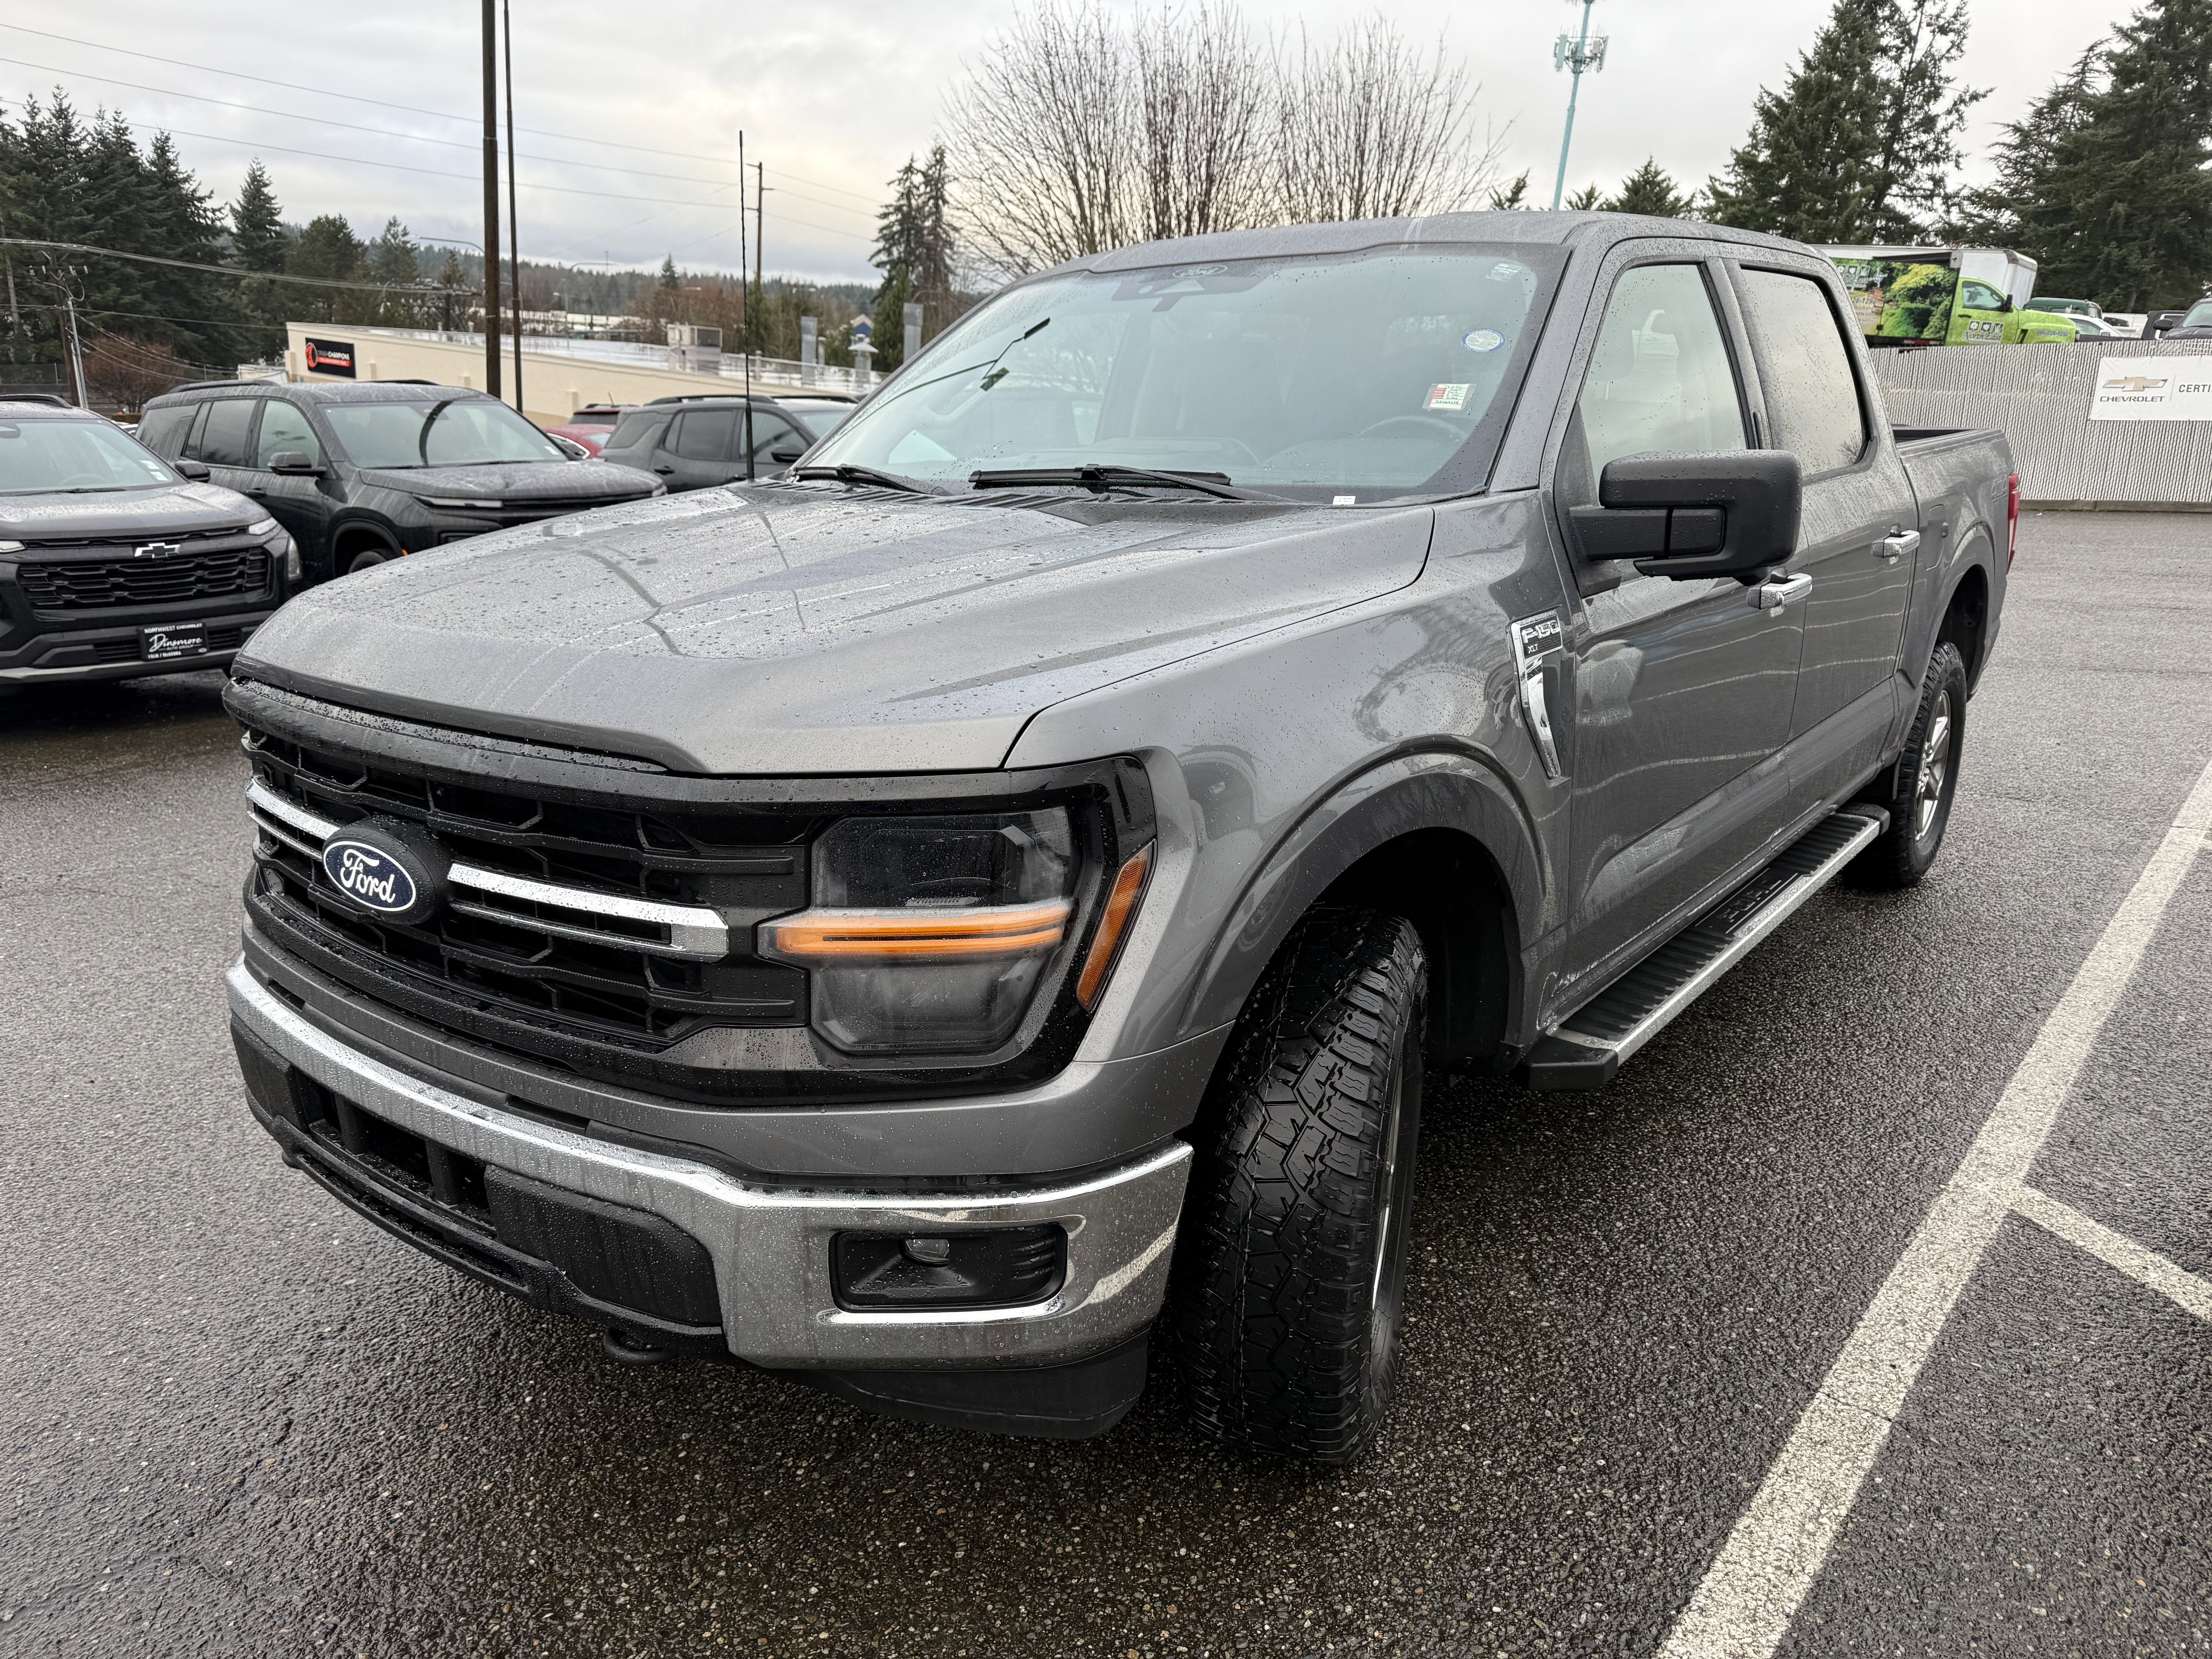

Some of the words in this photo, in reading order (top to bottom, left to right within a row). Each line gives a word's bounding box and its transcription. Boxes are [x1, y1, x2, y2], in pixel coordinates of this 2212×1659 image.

[1180, 266, 1219, 276] Ford
[2179, 384, 2212, 393] CERTI
[144, 625, 175, 634] NORTHWEST
[1522, 619, 1560, 644] F-150
[149, 633, 203, 653] Dinsmore
[1527, 643, 1538, 654] XLT
[340, 848, 396, 903] Ford
